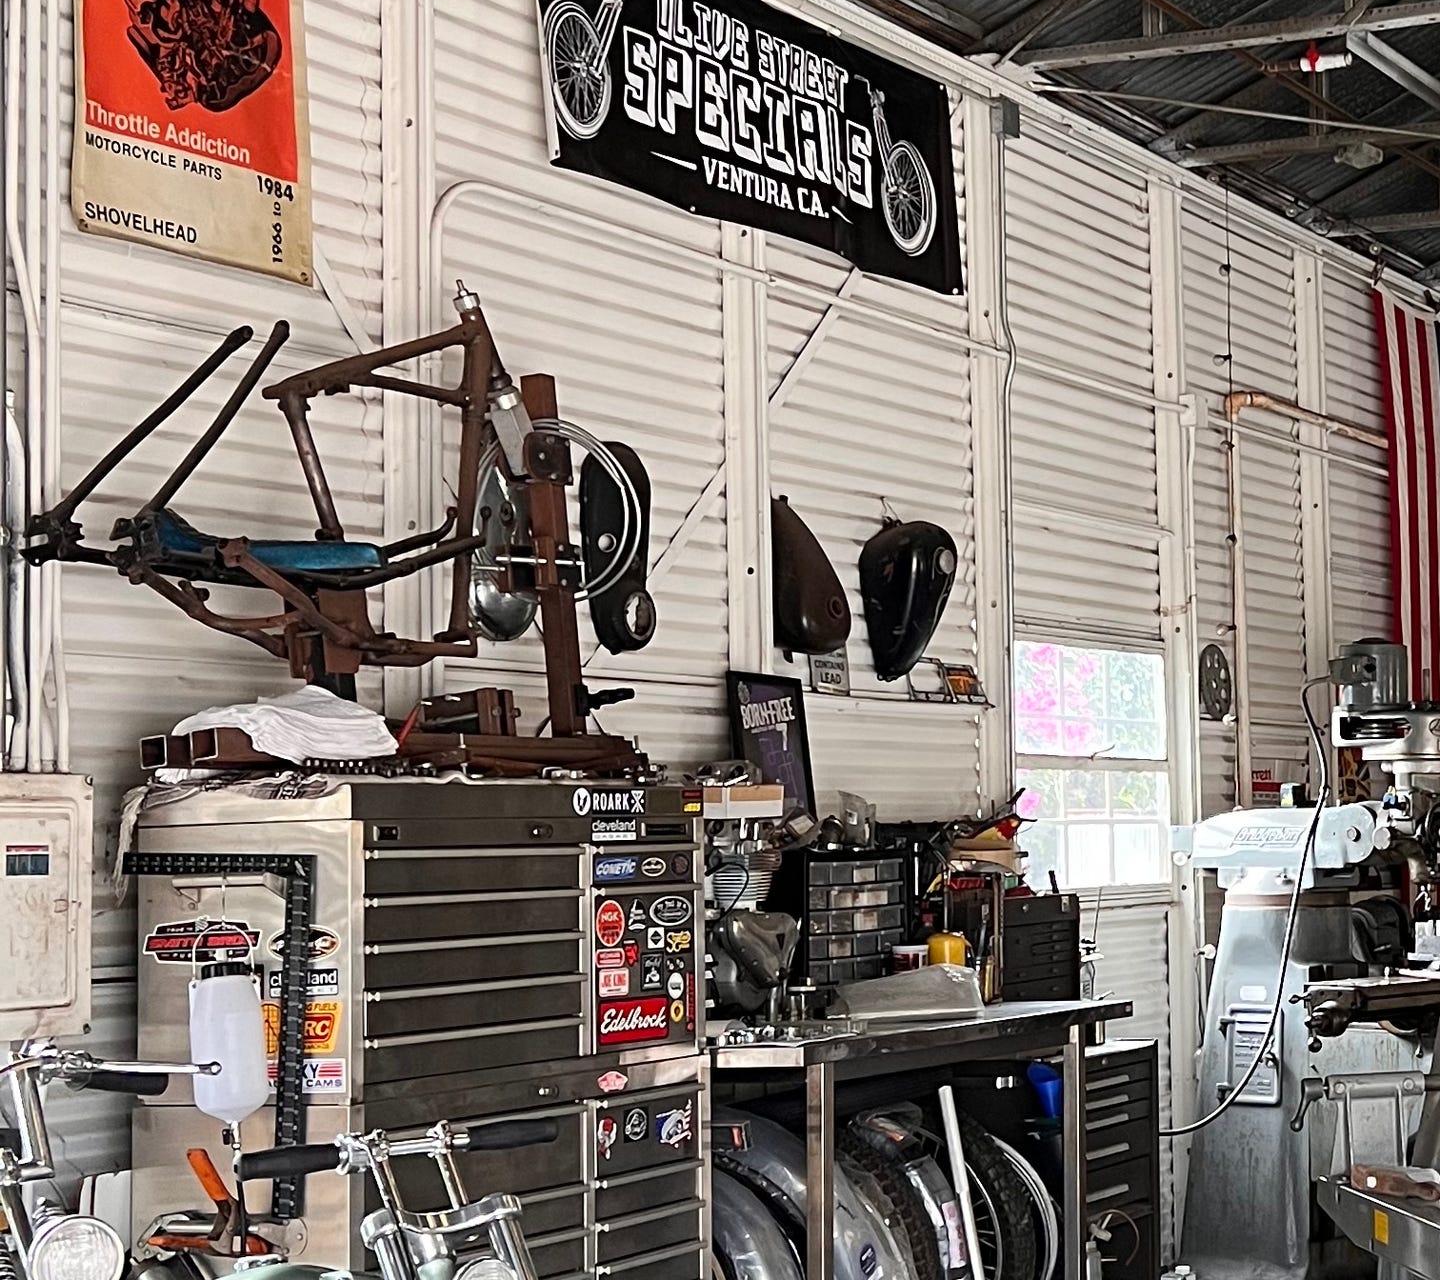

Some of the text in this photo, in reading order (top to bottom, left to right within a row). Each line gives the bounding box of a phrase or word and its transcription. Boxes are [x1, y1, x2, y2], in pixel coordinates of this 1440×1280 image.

[756, 30, 848, 112] STREET
[623, 25, 872, 208] SPECIALS
[86, 100, 250, 164] Throttle Addiction
[85, 132, 222, 181] MOTORCYCLE PARTS
[256, 175, 294, 202] 1984
[702, 155, 830, 219] VENTURA CA.
[84, 201, 197, 244] SHOVELHEAD
[272, 202, 283, 264] 1966 to
[820, 671, 842, 684] LEAD
[592, 793, 630, 811] ROARK
[592, 819, 636, 831] cleveland
[602, 912, 619, 922] NGK
[271, 970, 337, 986] clland
[305, 1020, 330, 1037] RC
[600, 1005, 667, 1034] Edelbrock
[306, 1079, 342, 1088] CAMS
